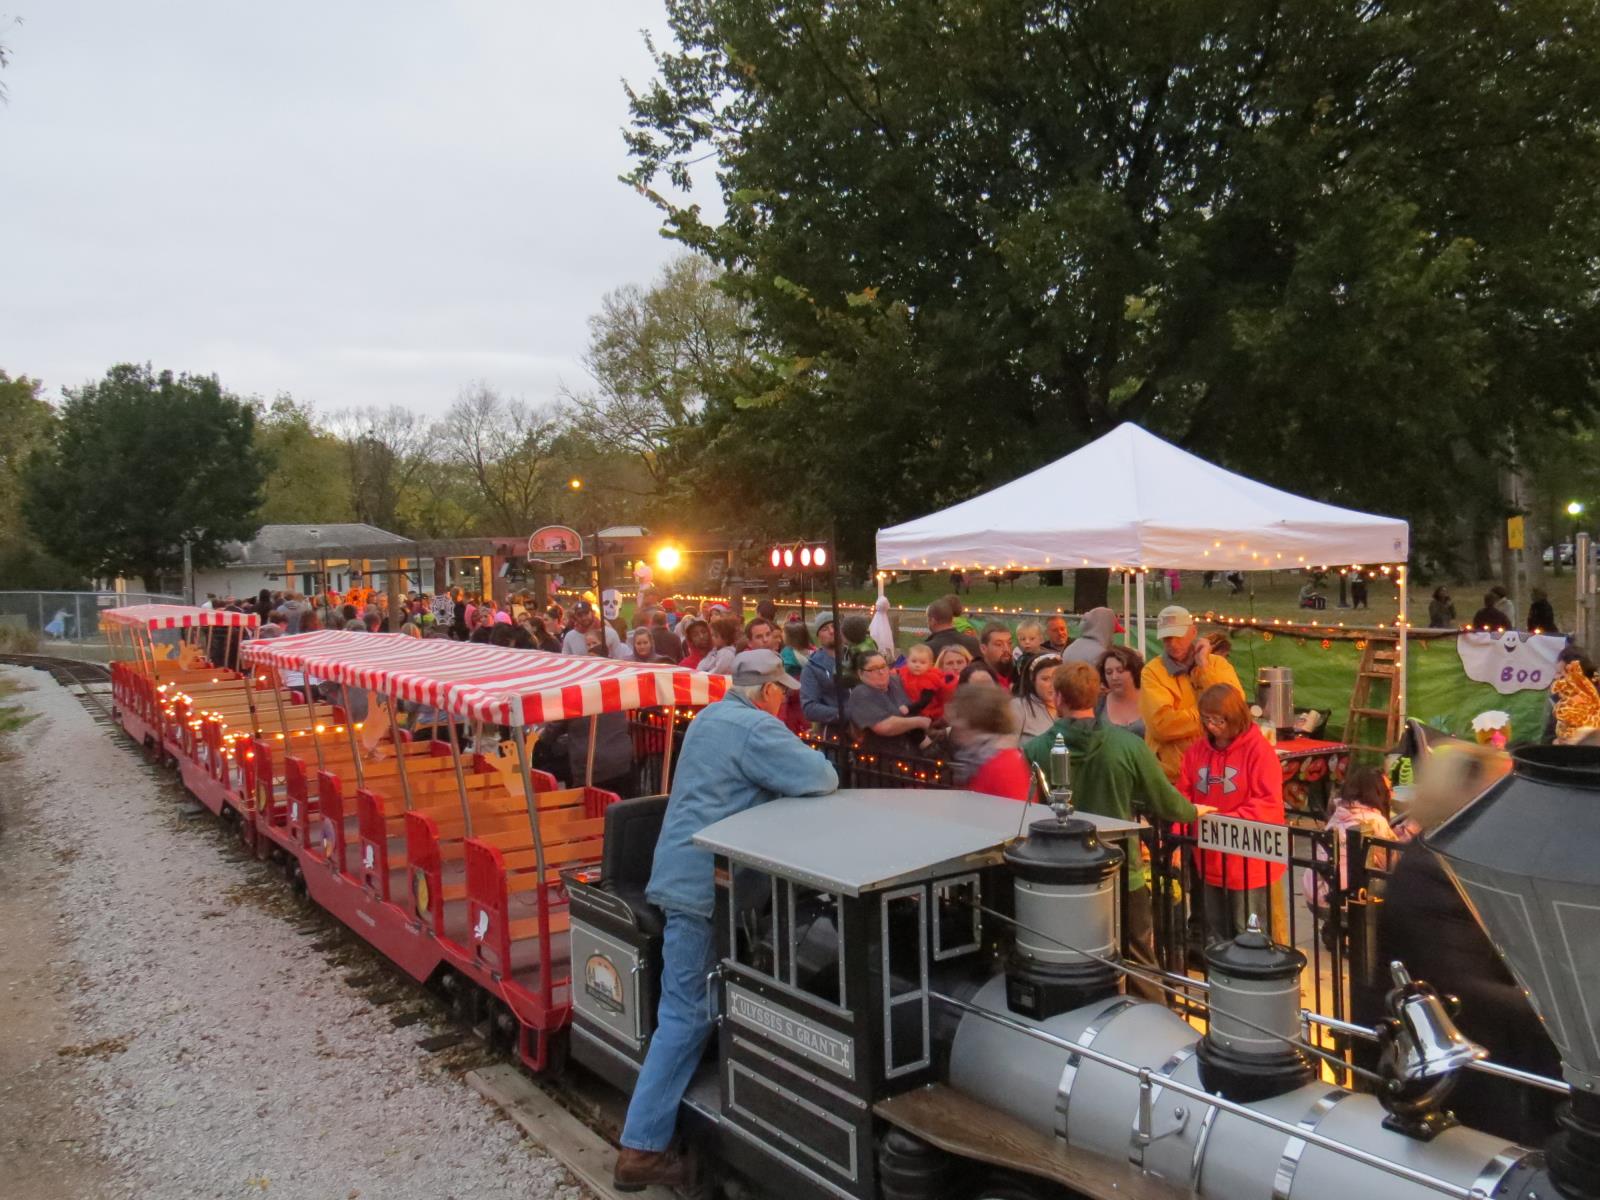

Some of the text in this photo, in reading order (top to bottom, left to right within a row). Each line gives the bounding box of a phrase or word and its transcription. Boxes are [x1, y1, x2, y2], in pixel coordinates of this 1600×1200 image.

[1501, 666, 1541, 683] BOO
[1201, 819, 1282, 856] ENTRANCE
[740, 1000, 838, 1057] ULYSSES S GRANT
